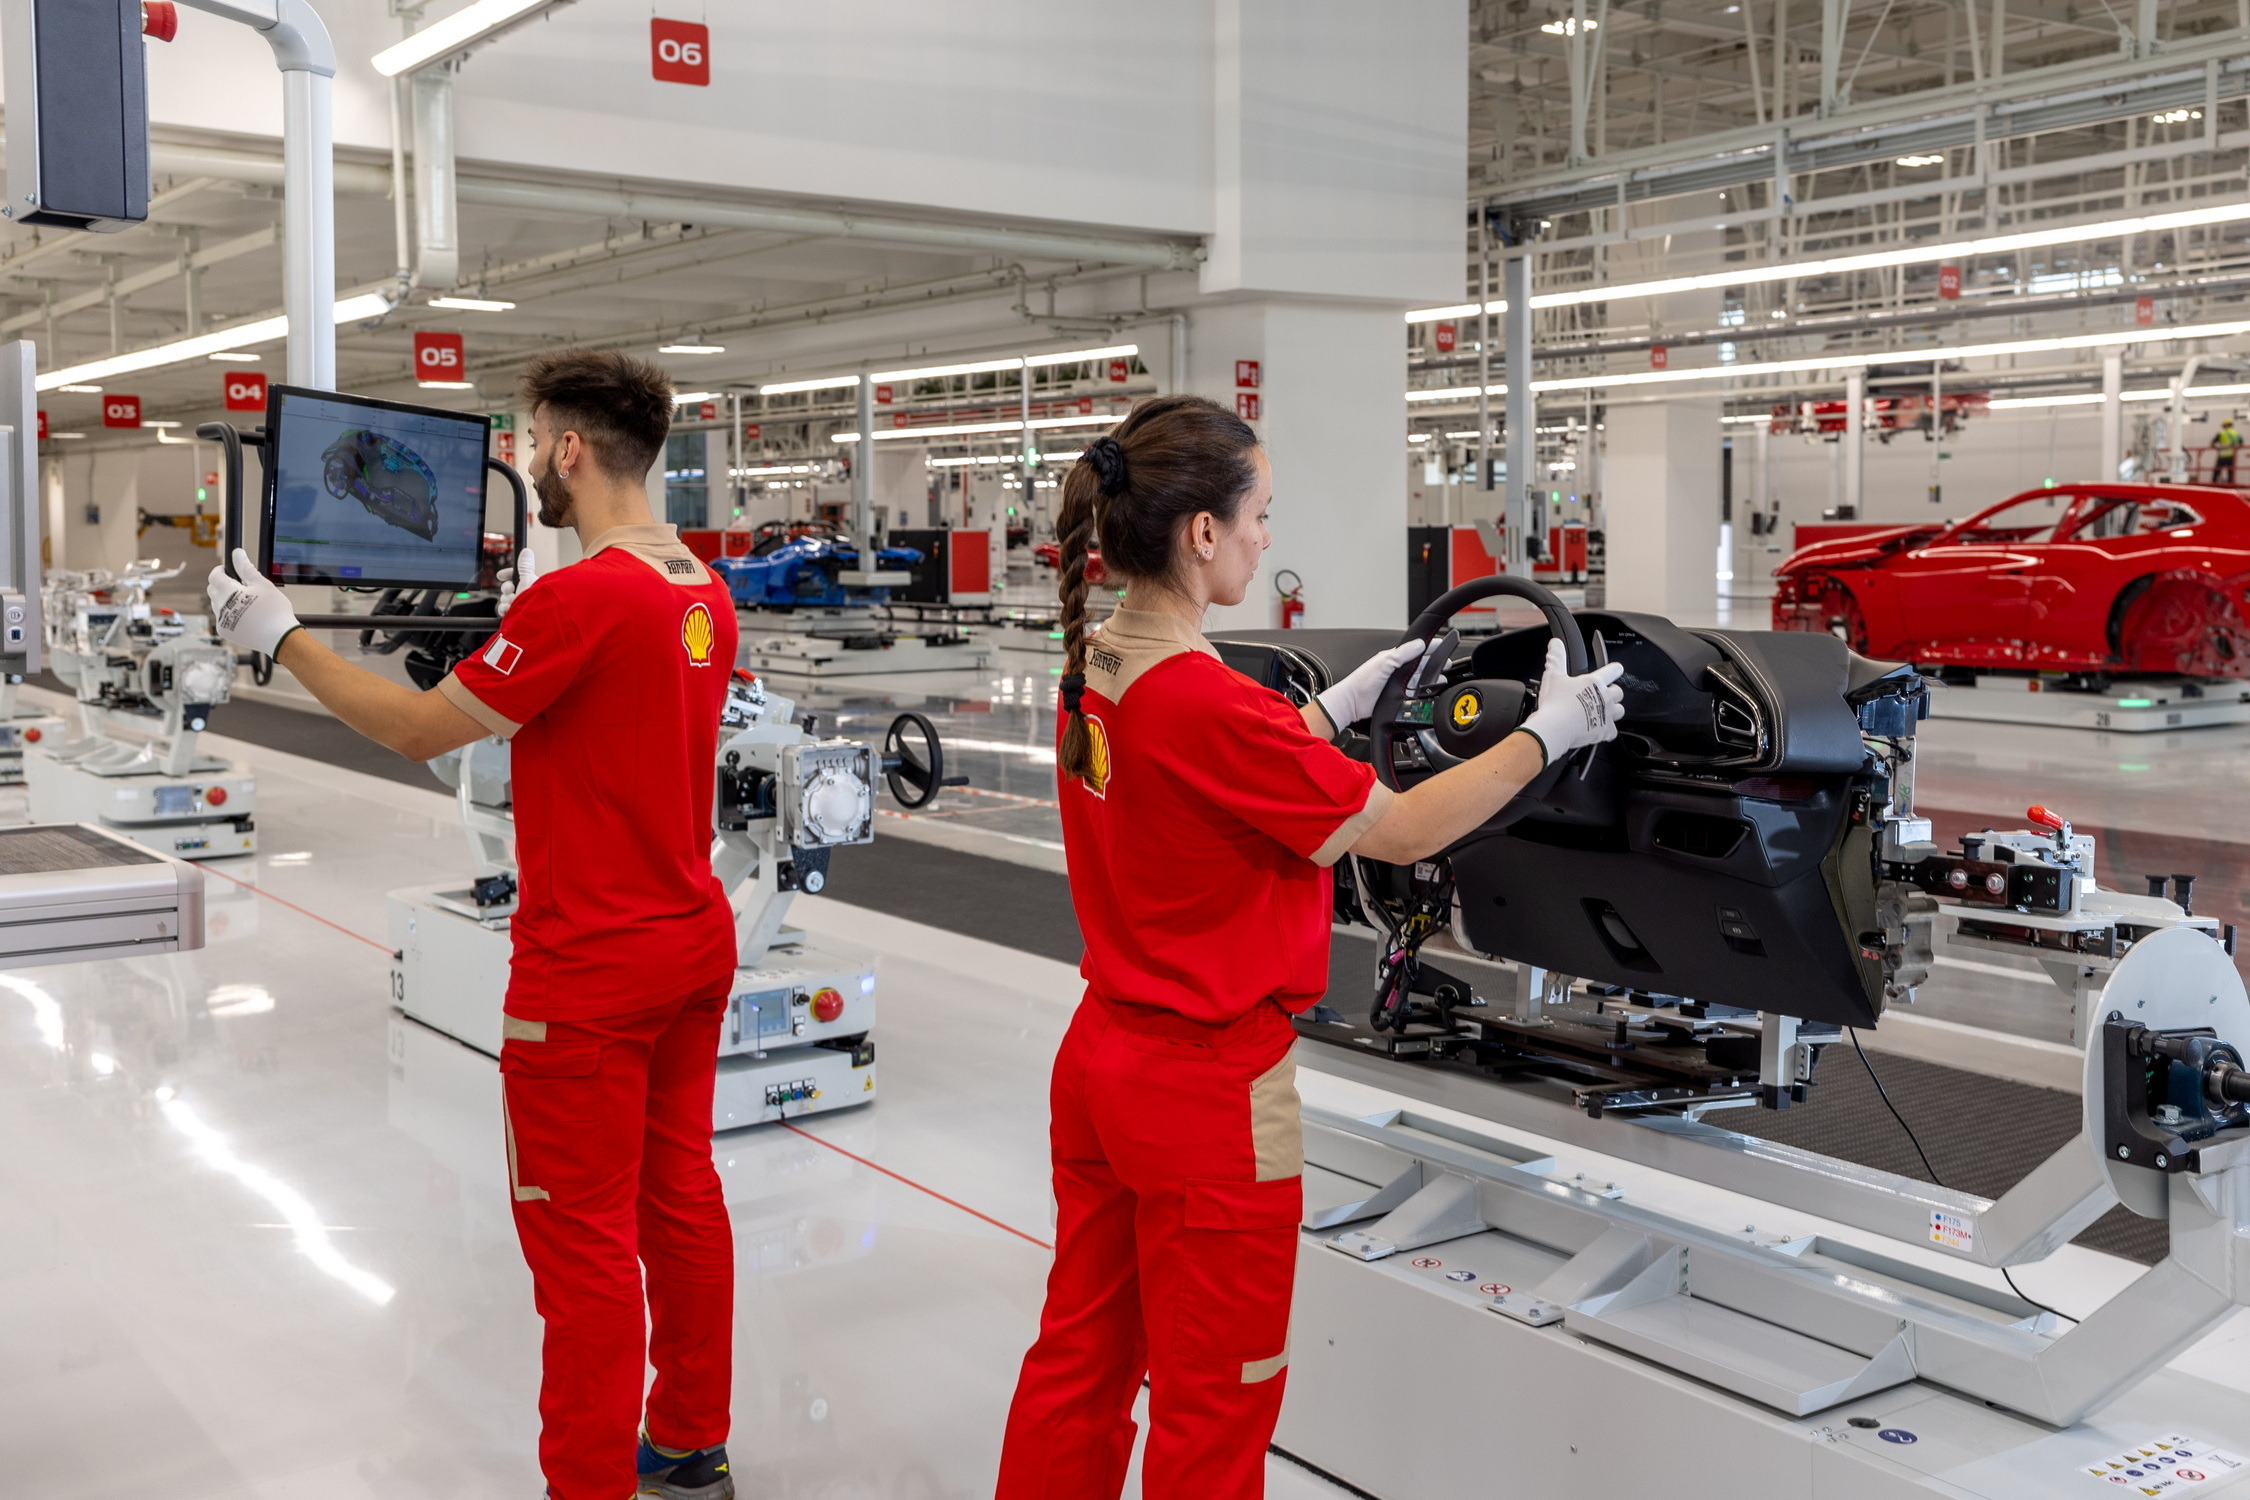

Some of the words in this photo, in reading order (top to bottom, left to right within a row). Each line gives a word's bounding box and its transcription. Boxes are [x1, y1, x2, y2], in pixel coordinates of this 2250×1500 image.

[658, 38, 703, 66] 06
[420, 346, 458, 367] 05
[229, 383, 263, 400] 04
[107, 403, 137, 419] 03
[664, 559, 696, 574] Ferrari
[1089, 647, 1124, 676] Ferrari
[390, 969, 405, 1001] 13
[1943, 1214, 1961, 1227] F175
[1943, 1224, 1968, 1240] F173M
